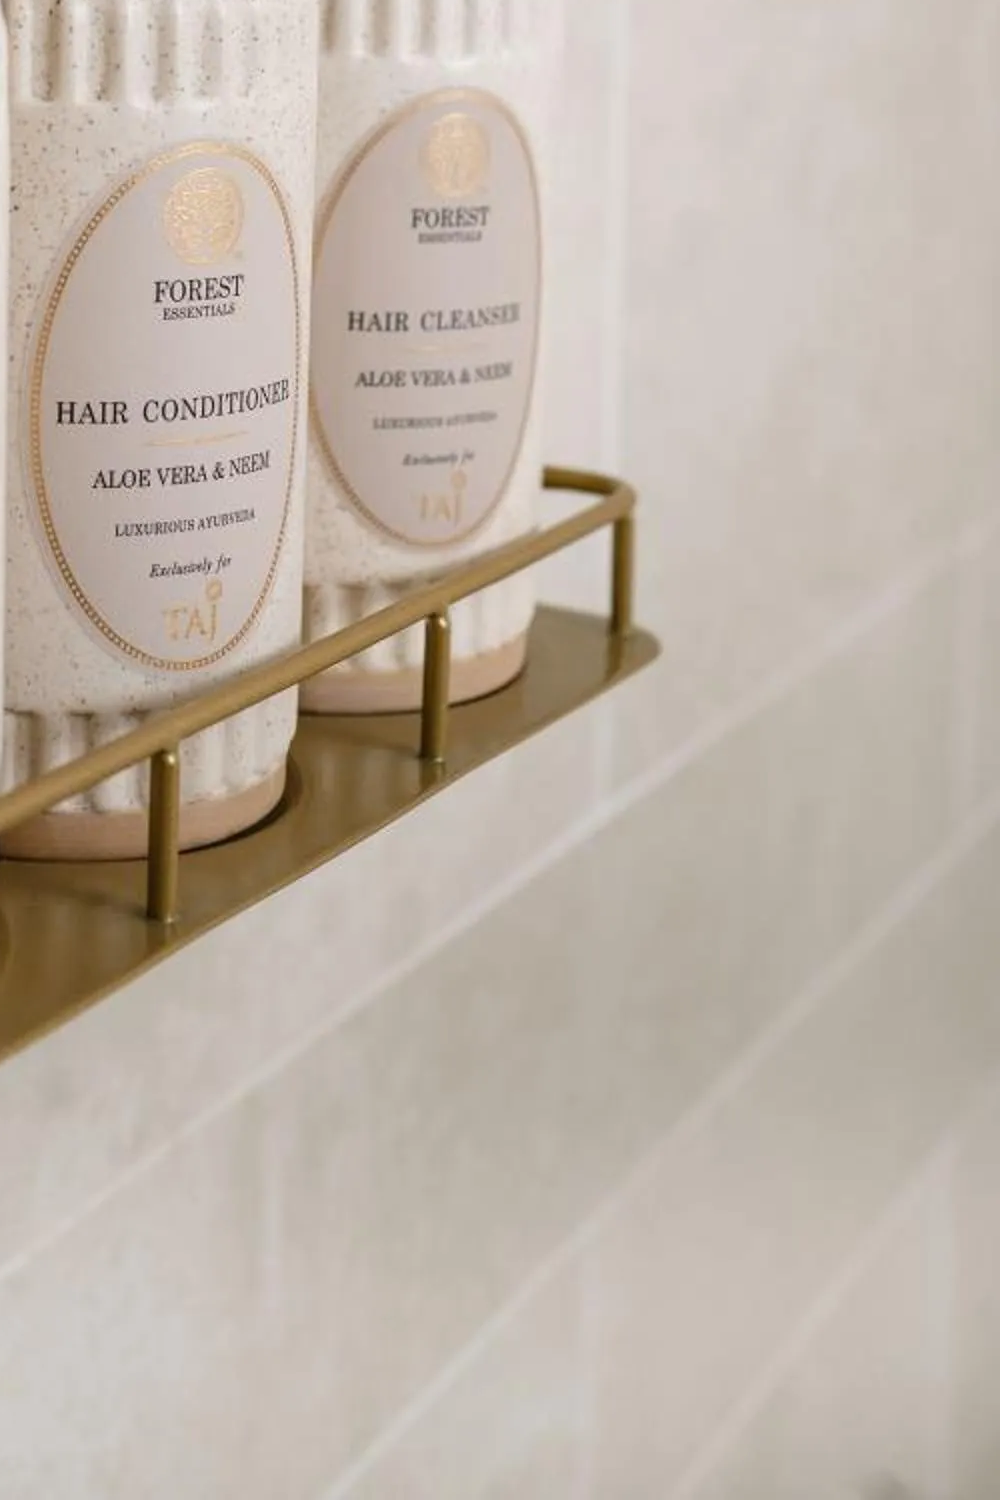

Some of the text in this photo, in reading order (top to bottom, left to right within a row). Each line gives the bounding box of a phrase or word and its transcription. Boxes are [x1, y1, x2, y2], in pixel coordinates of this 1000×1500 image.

[411, 205, 490, 229] FOREST
[153, 274, 245, 304] FOREST
[162, 303, 236, 321] ESSENTIALS
[346, 302, 521, 332] HAIR CLEANSER
[354, 361, 513, 389] ALOE VERA & NEEM
[55, 379, 291, 426] HAIR CONDITIONER
[91, 450, 271, 490] ALOE VERA & NEEM
[114, 508, 256, 538] LUXURIOUS AYURVEDA
[148, 554, 233, 580] Exclusively for
